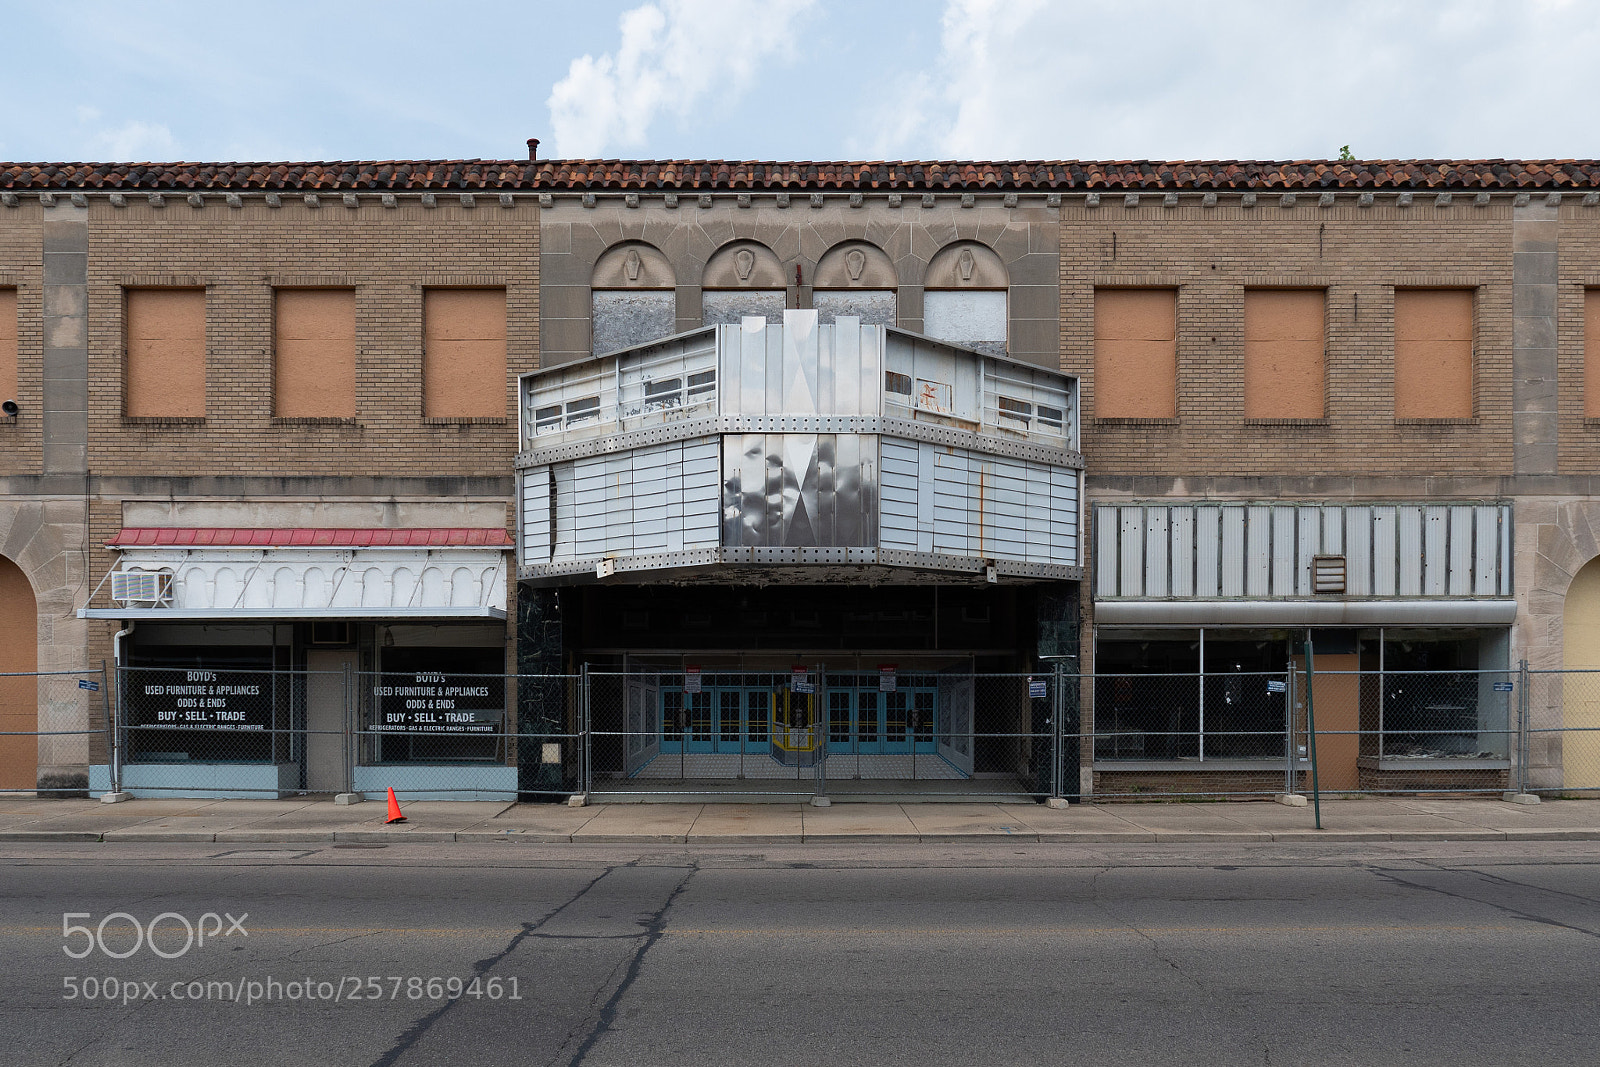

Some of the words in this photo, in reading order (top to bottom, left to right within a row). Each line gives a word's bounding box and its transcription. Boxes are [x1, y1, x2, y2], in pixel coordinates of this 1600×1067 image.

[187, 671, 217, 682] BOYD's
[145, 685, 164, 695] USED
[166, 685, 207, 695] FURNITURE
[208, 685, 214, 695] &
[216, 685, 260, 695] APPLIANCES
[373, 687, 392, 696] USED
[394, 687, 435, 696] FURNITURE
[437, 687, 443, 696] &
[445, 687, 489, 696] APPLIANCES
[177, 698, 197, 708] ODDS
[199, 698, 205, 708] &
[207, 698, 226, 708] ENDS
[406, 699, 426, 709] ODDS
[428, 699, 434, 709] &
[436, 699, 455, 709] ENDS
[158, 711, 177, 721] BUY
[185, 711, 207, 721] SELL
[215, 711, 246, 721] TRADE
[386, 713, 406, 722] BUY
[414, 713, 437, 722] SELL
[445, 713, 475, 722] TRADE
